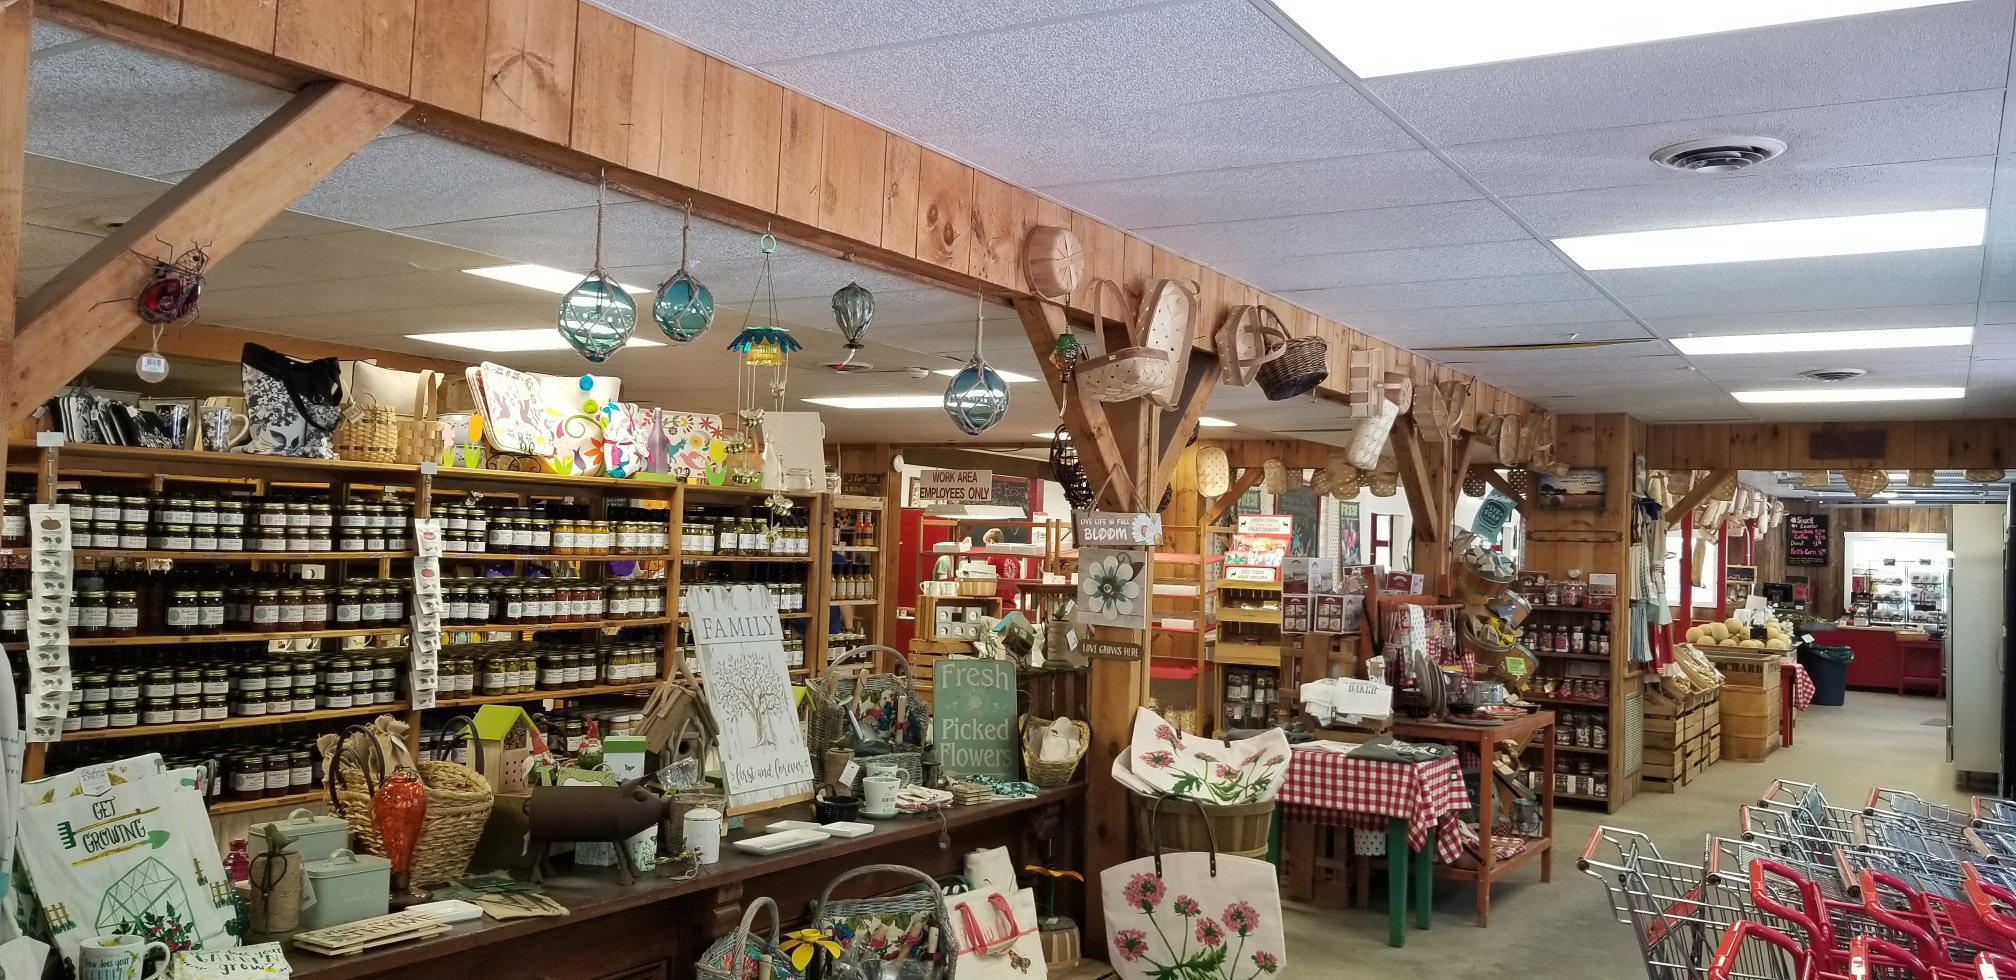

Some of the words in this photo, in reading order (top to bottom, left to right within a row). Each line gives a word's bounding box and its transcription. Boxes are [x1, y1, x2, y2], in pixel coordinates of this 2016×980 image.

[933, 471, 955, 483] WORK
[957, 471, 978, 483] AREA
[920, 487, 965, 499] EMPLOYEES
[968, 487, 990, 500] ONLY
[1483, 510, 1500, 521] SOAP
[1083, 527, 1128, 541] BLOOM
[702, 615, 775, 640] FAMILY
[1082, 643, 1098, 653] LOVE
[1099, 644, 1122, 655] GROWS
[1124, 647, 1139, 657] HERE
[942, 663, 1010, 691] Fresh
[941, 717, 1010, 740] Picked
[939, 742, 1013, 767] Flowers
[735, 763, 756, 784] first
[757, 764, 772, 779] and
[774, 757, 804, 780] forever
[92, 796, 116, 820] GET
[82, 818, 146, 853] GROWING
[255, 947, 282, 958] your
[85, 958, 97, 968] How
[100, 959, 114, 968] does
[115, 958, 129, 972] your
